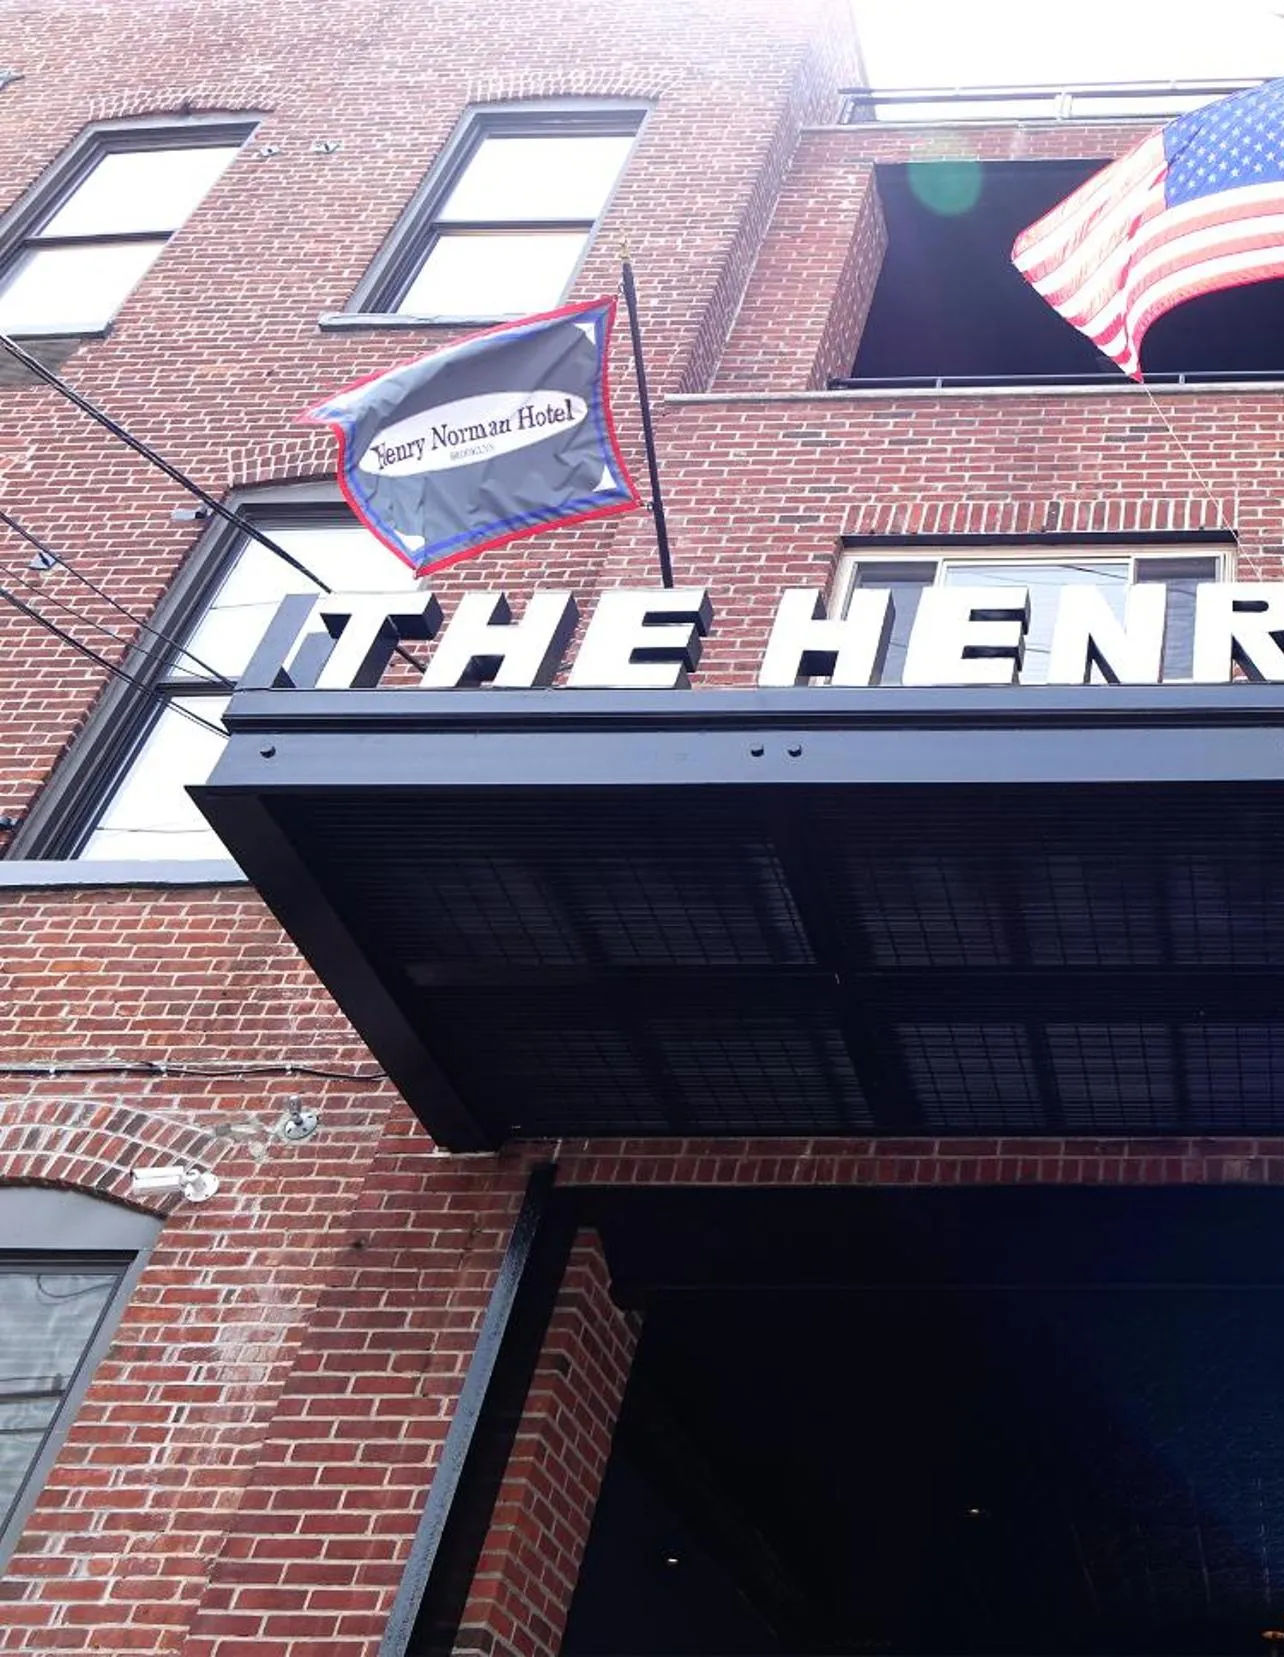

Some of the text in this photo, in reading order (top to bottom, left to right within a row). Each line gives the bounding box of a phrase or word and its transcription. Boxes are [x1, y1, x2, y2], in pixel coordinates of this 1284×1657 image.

[370, 398, 575, 470] Henry Norman Hotel
[305, 590, 708, 689] THE
